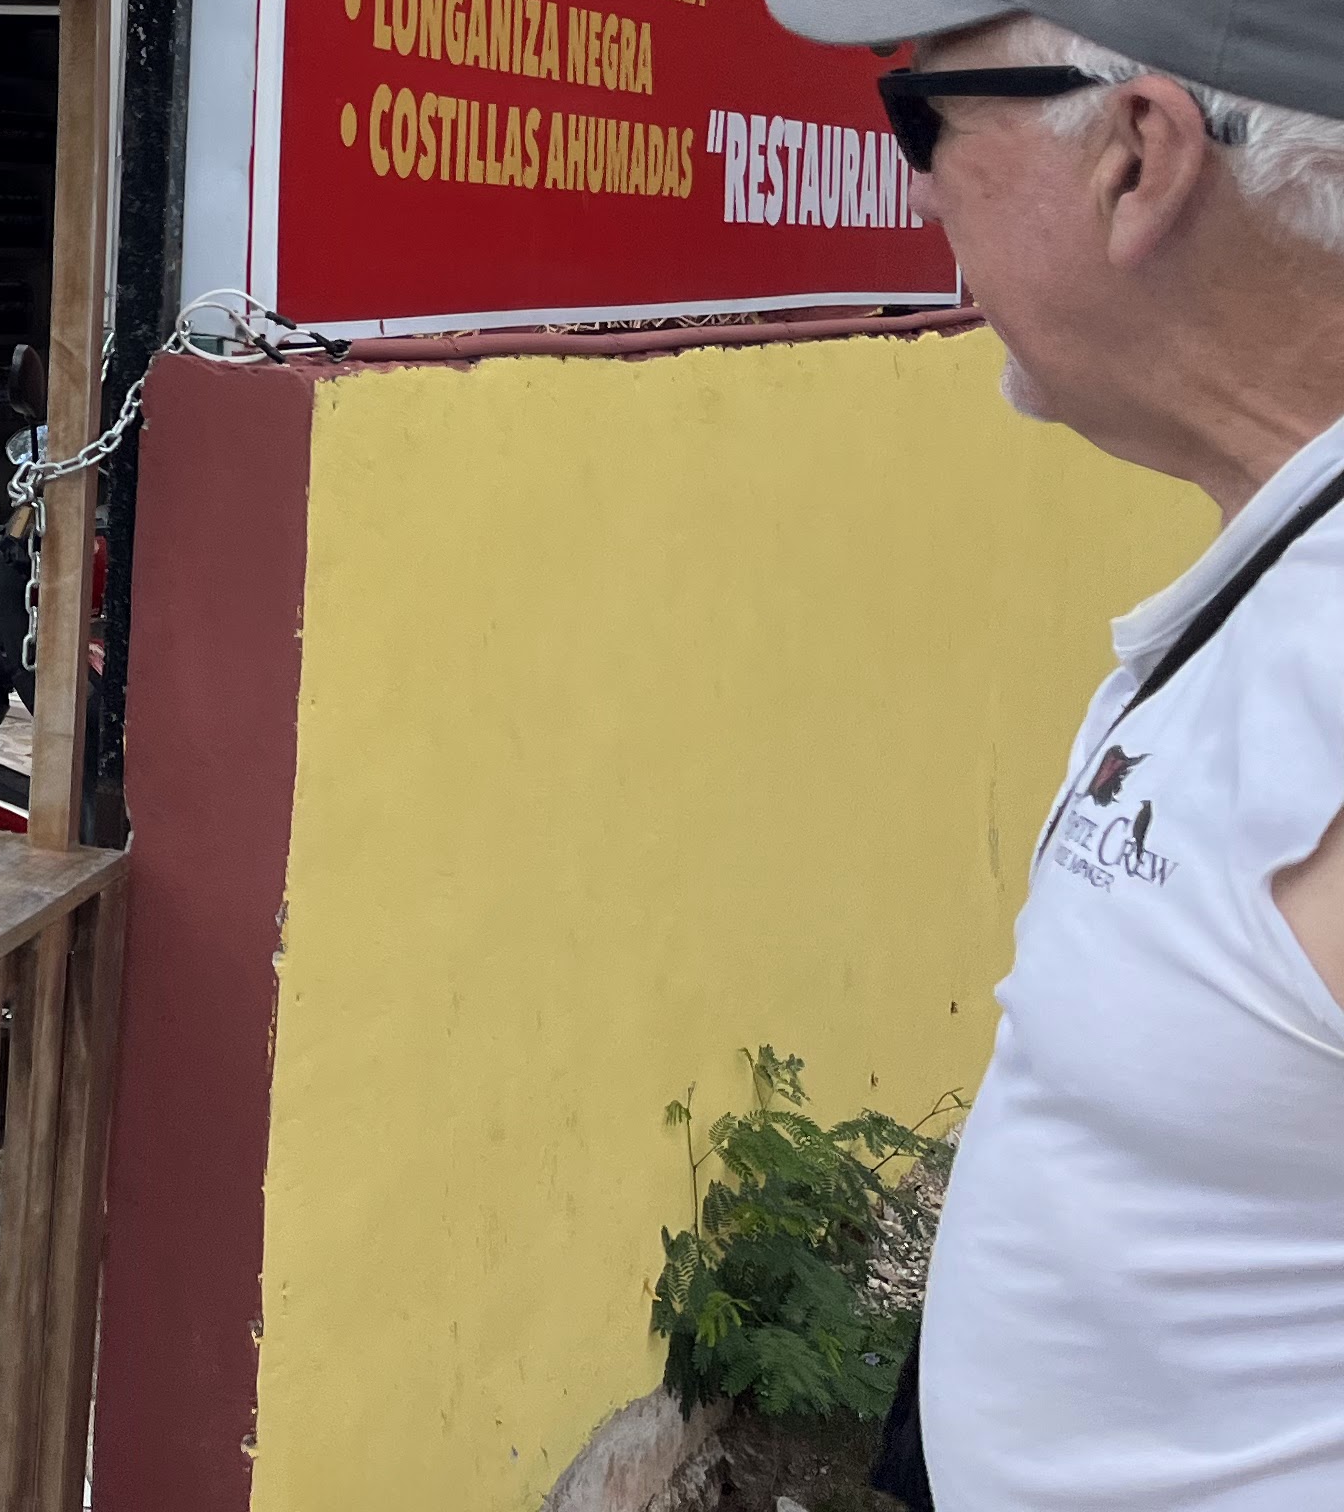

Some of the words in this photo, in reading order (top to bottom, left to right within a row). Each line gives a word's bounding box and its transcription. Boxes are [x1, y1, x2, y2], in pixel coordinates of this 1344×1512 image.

[566, 6, 654, 96] NEGRA
[369, 83, 542, 190] COSTILLAS
[544, 112, 694, 200] AHUMADAS
[706, 108, 924, 230] "RESTAURANT
